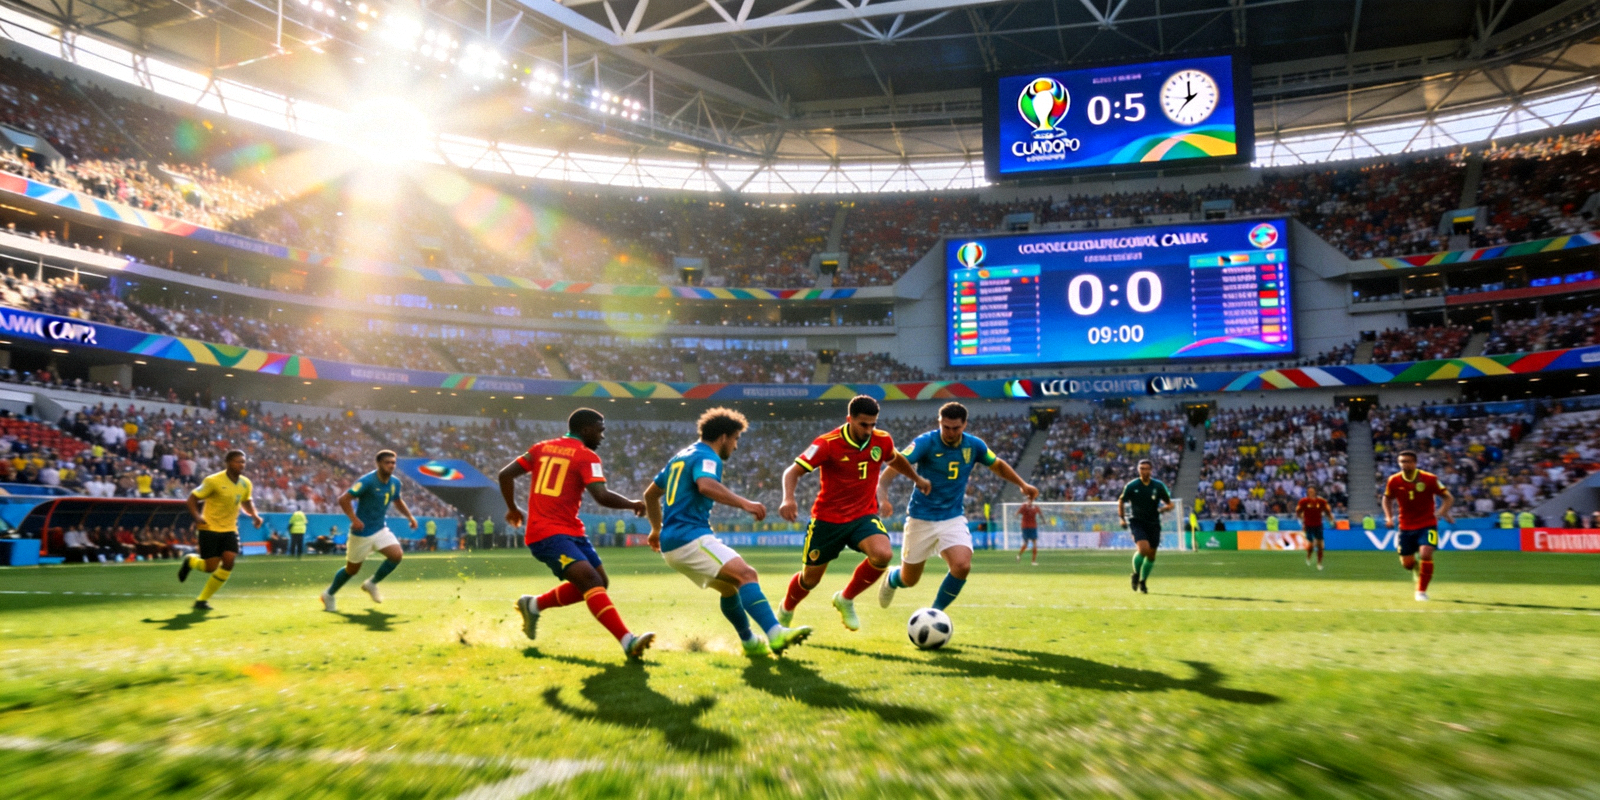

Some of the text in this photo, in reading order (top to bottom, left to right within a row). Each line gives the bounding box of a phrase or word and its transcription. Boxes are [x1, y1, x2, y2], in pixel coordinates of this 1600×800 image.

[1087, 92, 1146, 126] 0:5
[1068, 270, 1162, 315] 0:0
[1088, 325, 1144, 344] 09:00
[534, 455, 570, 497] 10
[947, 461, 960, 480] 5
